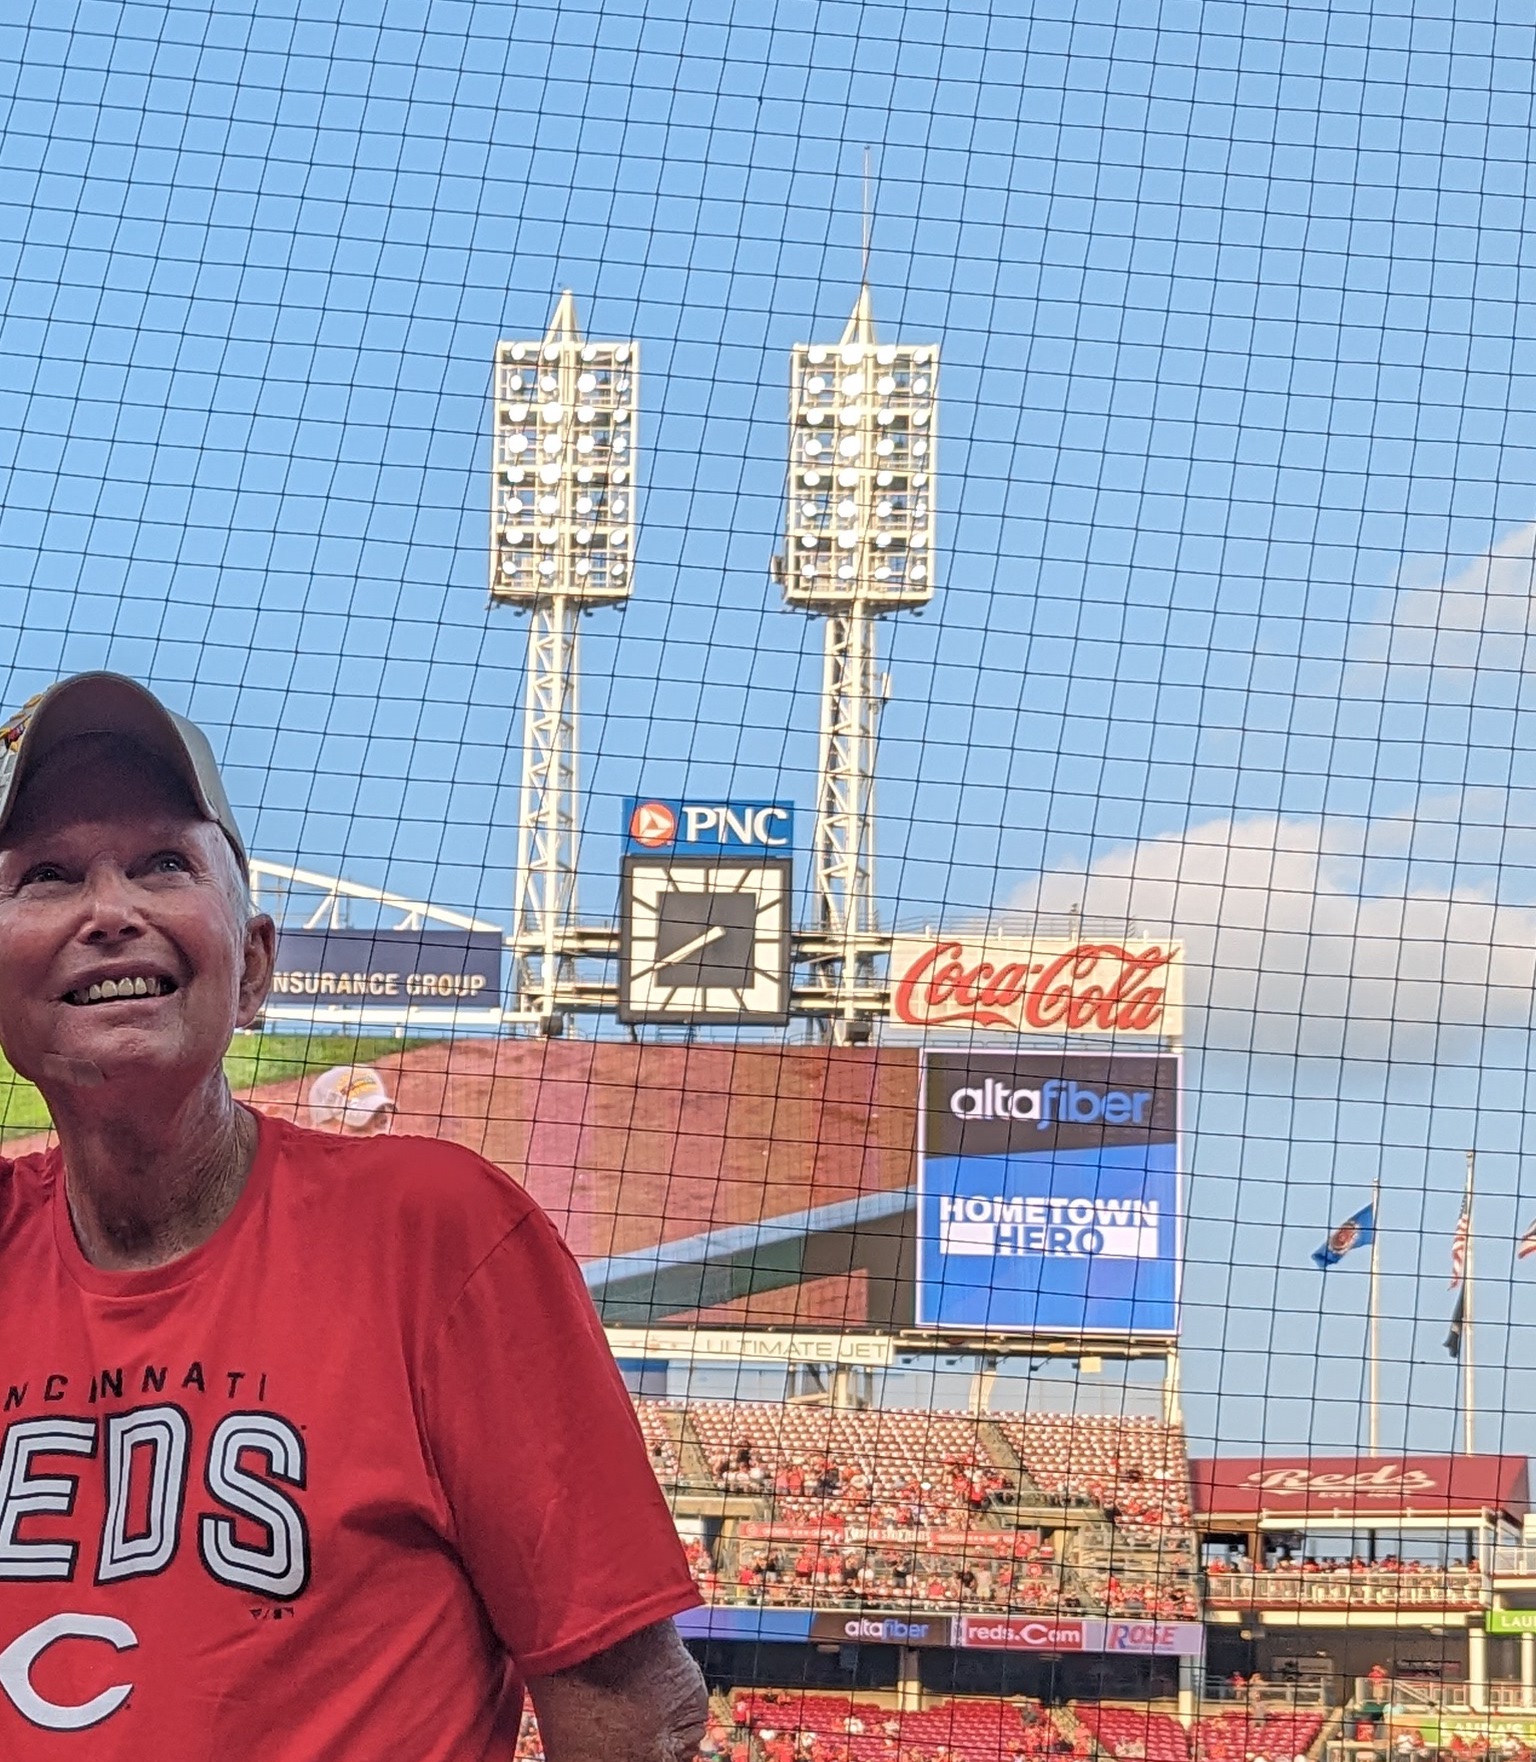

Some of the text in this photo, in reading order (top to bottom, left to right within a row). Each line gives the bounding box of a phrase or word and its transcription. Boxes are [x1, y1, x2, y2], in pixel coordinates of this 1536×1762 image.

[684, 806, 789, 846] PNC
[272, 971, 487, 997] NSURANCE GROUP
[894, 940, 1182, 1030] Coca-Cola
[950, 1078, 1153, 1131] altafiber
[939, 1194, 1160, 1228] HOMETOWN
[994, 1225, 1105, 1256] HERO
[706, 1339, 887, 1359] ULTIMATE JET
[1236, 1464, 1437, 1496] Reds
[843, 1618, 931, 1641] altafiber
[1500, 1615, 1536, 1628] LAU
